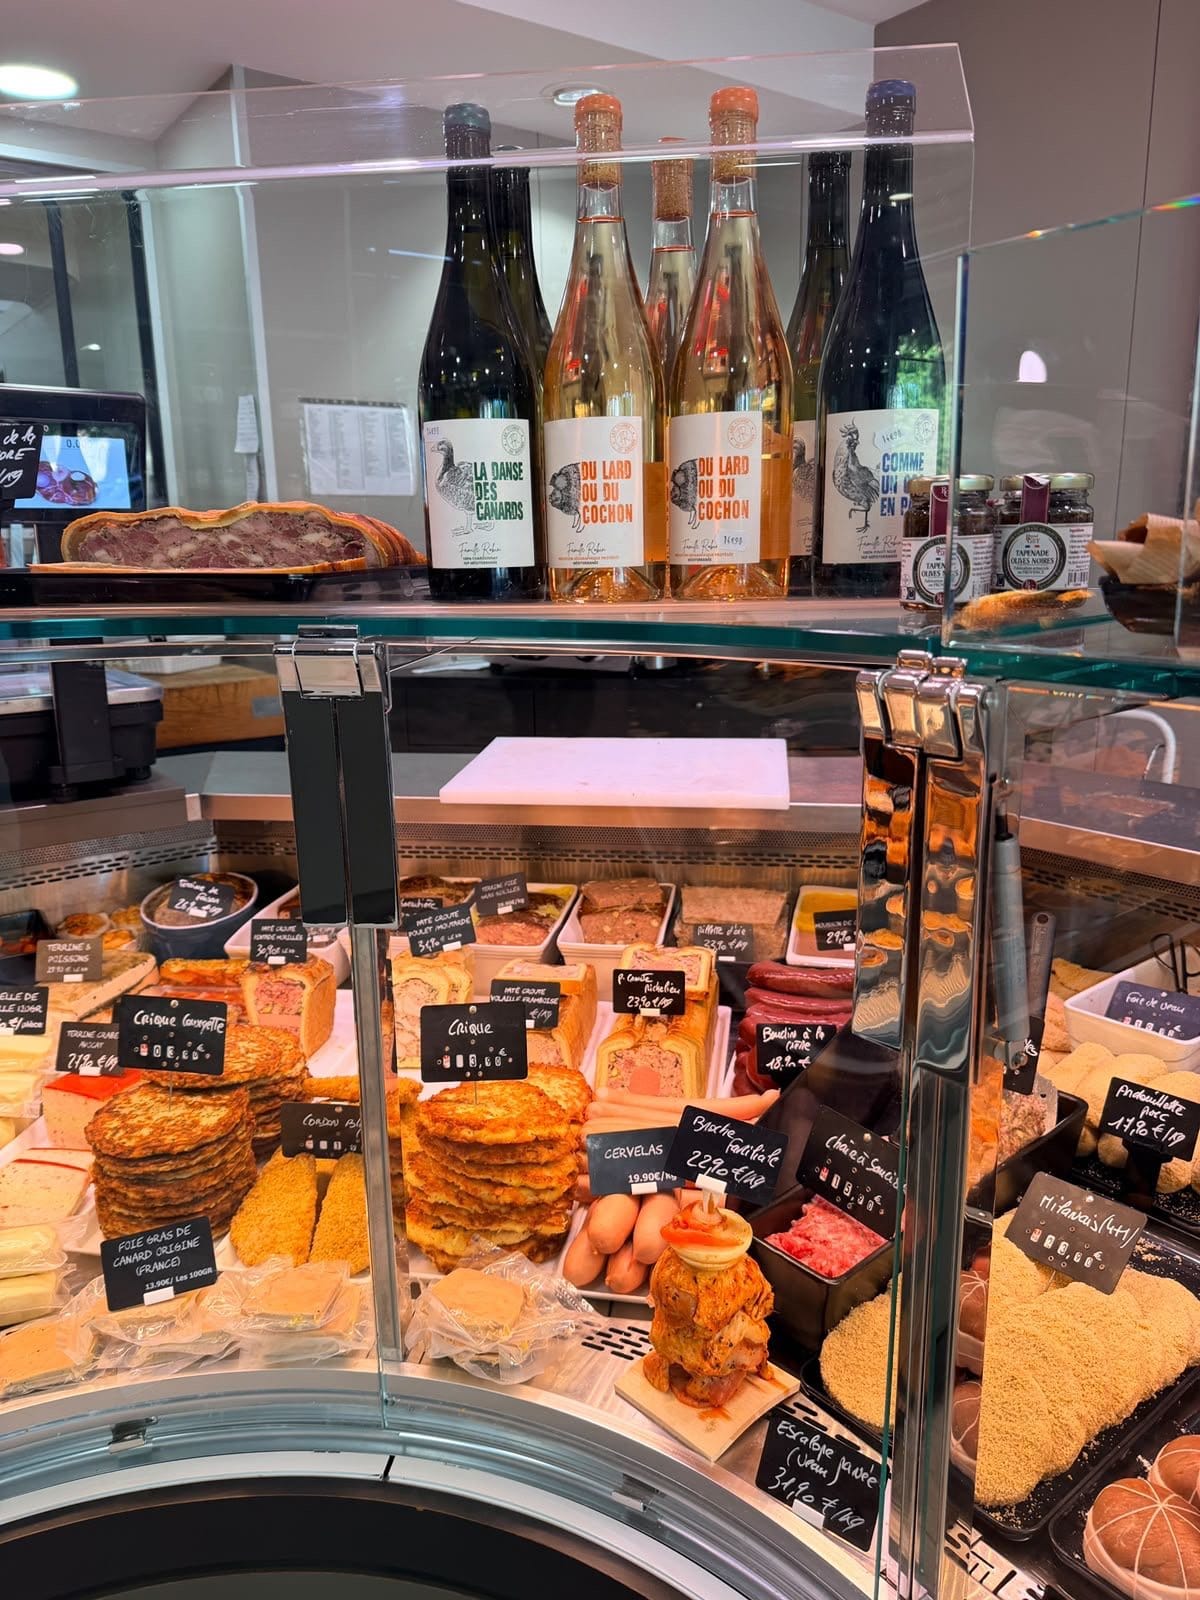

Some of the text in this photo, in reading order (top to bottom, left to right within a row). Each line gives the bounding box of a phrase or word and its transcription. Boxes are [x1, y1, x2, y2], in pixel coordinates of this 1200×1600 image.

[473, 461, 523, 481] LA DANSE
[582, 460, 632, 481] DU LARD
[698, 455, 749, 476] DU LARD
[882, 452, 925, 472] COMME
[475, 481, 497, 501] DES
[582, 482, 620, 502] OU DU
[699, 478, 735, 498] OU DU
[881, 475, 897, 494] UN
[476, 501, 523, 521] CANARDS
[582, 504, 633, 524] COCHON
[698, 499, 749, 520] COCHON
[880, 497, 896, 517] EN
[47, 943, 85, 951] TERRINE
[48, 954, 89, 963] POISSONS
[24, 992, 40, 1001] DE
[522, 996, 559, 1005] FRAMBOISE
[67, 1030, 96, 1038] TERRINE
[1115, 1084, 1187, 1116] Andouillette
[604, 1143, 664, 1159] CERVELAS
[118, 1224, 191, 1252] FOIE GRAS DE
[113, 1236, 200, 1267] CANARD ORIGINE
[135, 1256, 181, 1276] (FRANCE)
